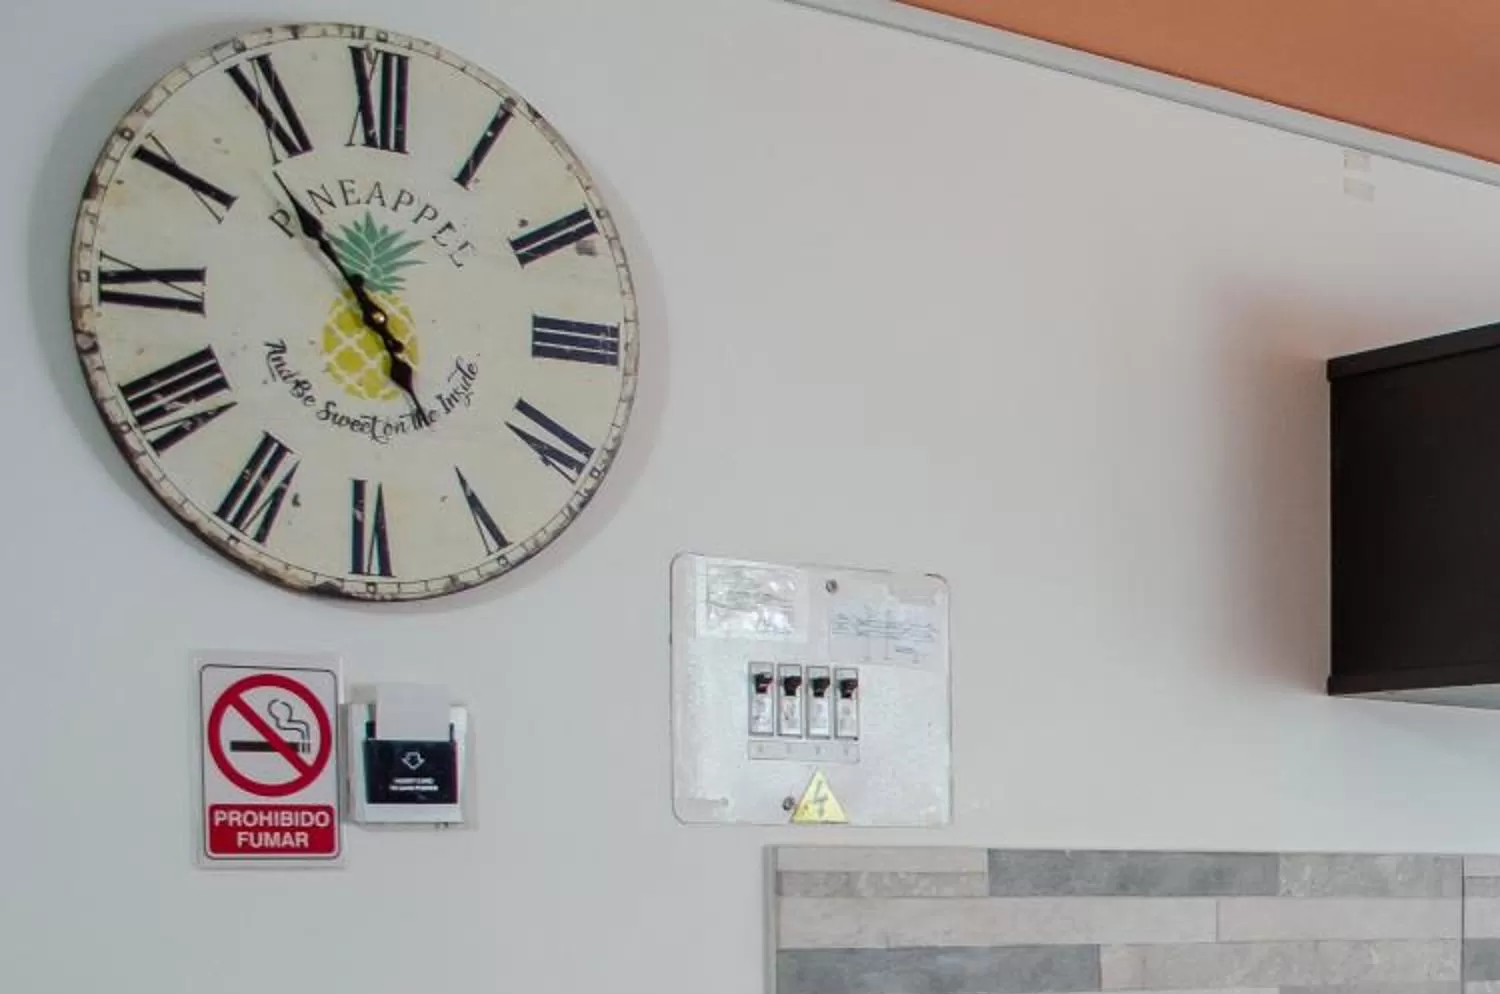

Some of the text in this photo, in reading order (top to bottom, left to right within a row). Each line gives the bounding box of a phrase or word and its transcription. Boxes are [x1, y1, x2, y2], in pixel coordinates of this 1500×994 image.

[224, 53, 313, 164] XI
[346, 46, 409, 153] XII
[453, 98, 515, 189] I
[131, 133, 238, 223] X
[268, 179, 476, 269] PNEAPPLE
[508, 205, 600, 268] II
[98, 252, 207, 315] IX
[531, 314, 620, 366] III
[118, 345, 238, 456] VIII
[316, 400, 388, 444] Sweet
[504, 399, 596, 485] IV
[215, 431, 301, 544] VII
[349, 479, 396, 578] VI
[455, 465, 513, 556] V
[213, 810, 331, 828] PROHIBIDO
[236, 831, 310, 849] FUMAR
